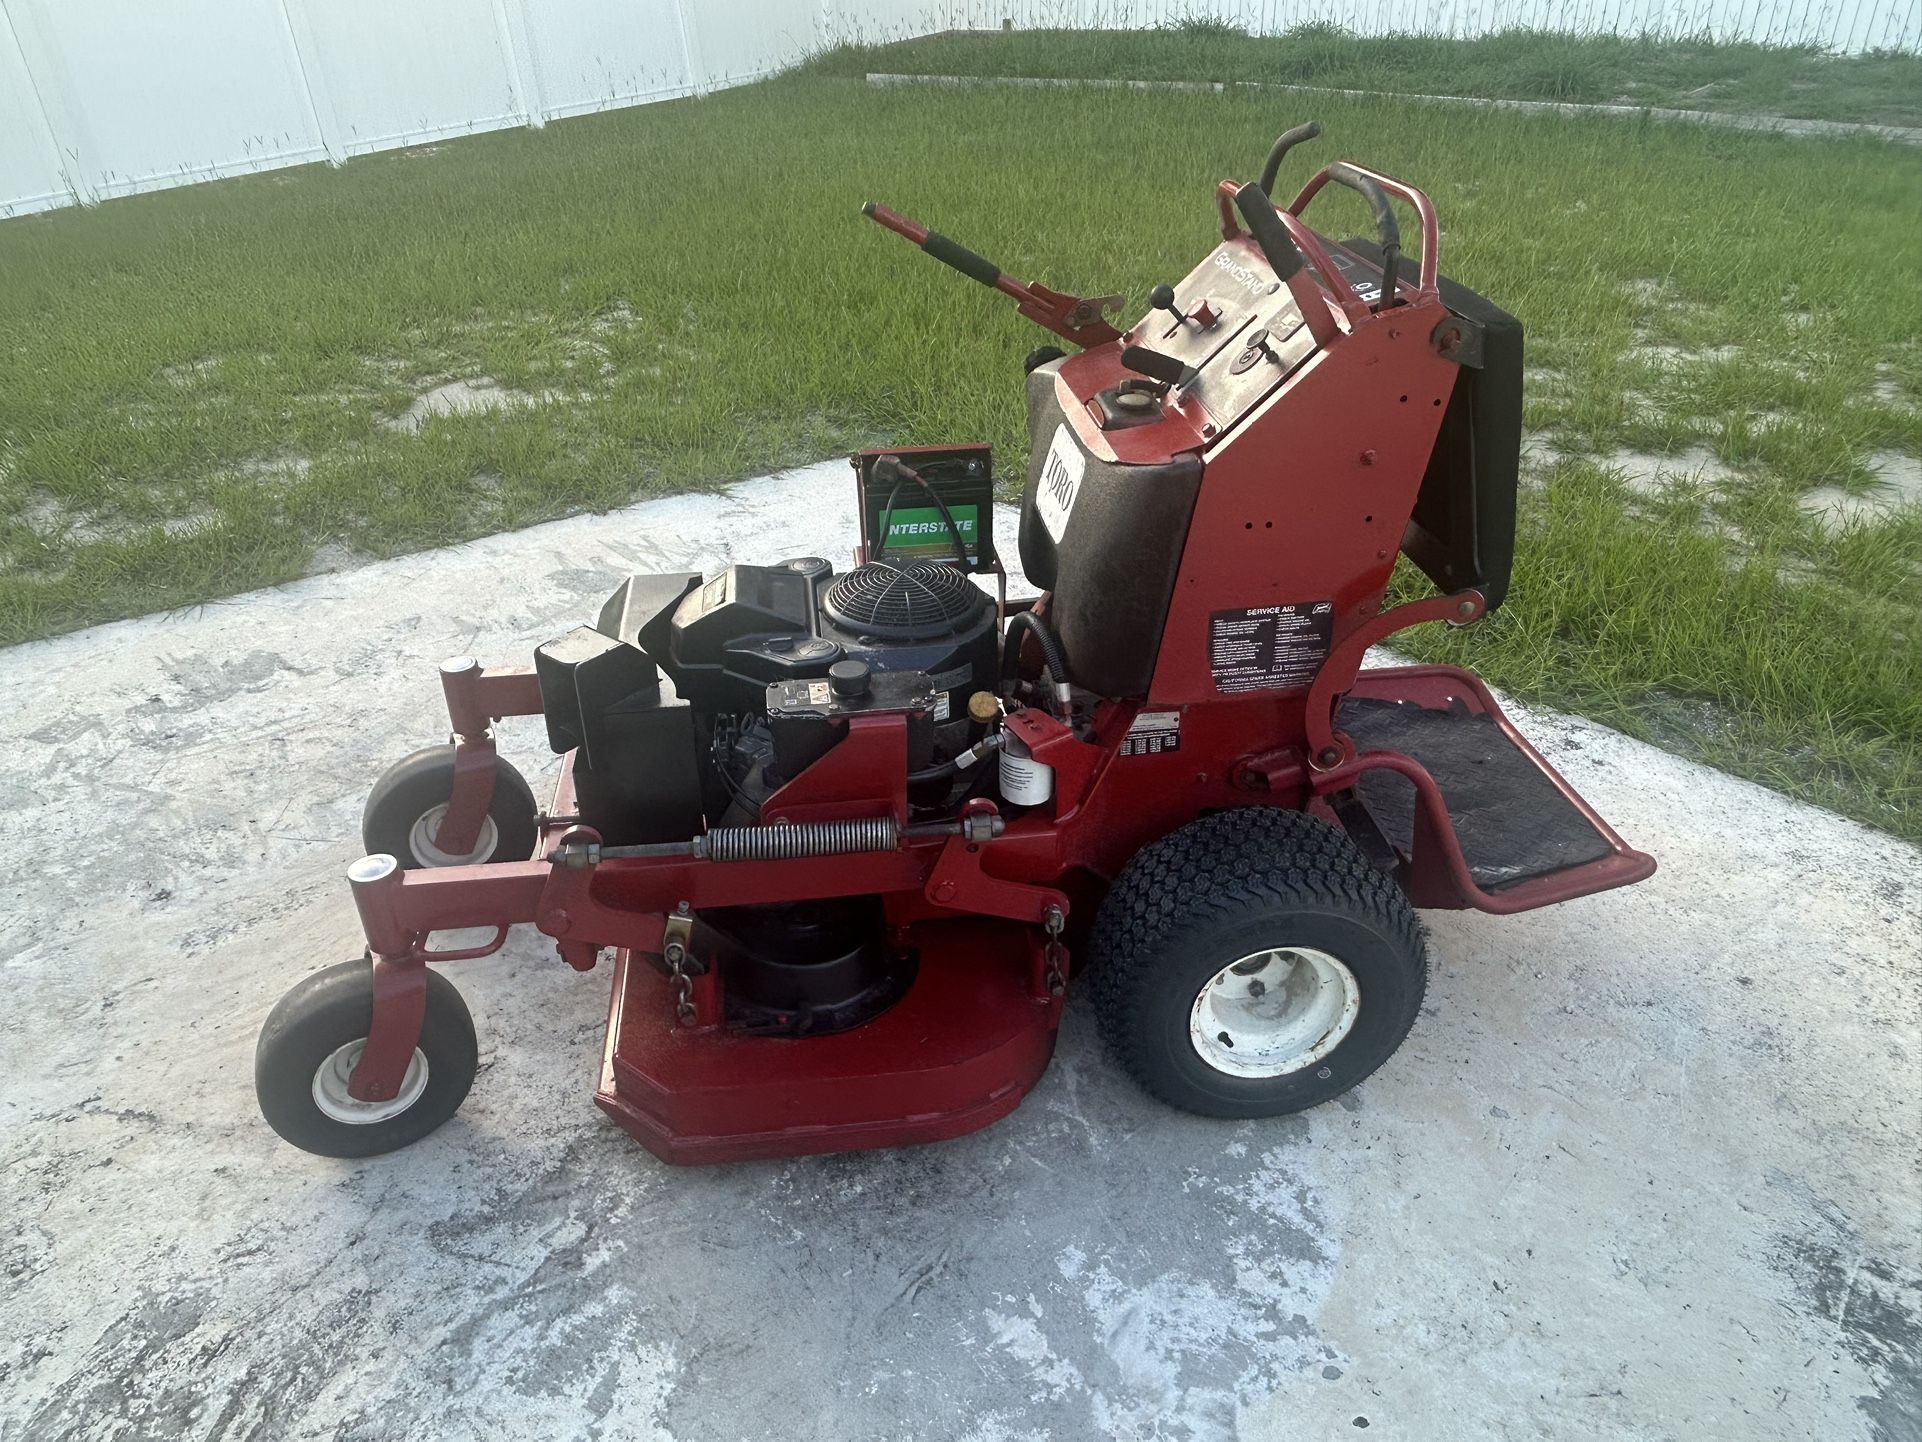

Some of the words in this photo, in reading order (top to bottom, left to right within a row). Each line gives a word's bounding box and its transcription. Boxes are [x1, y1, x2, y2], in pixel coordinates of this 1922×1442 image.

[1046, 448, 1074, 512] TORO
[888, 519, 973, 536] NTERSTTE
[1246, 606, 1280, 616] SERVICE
[1281, 605, 1296, 613] AID
